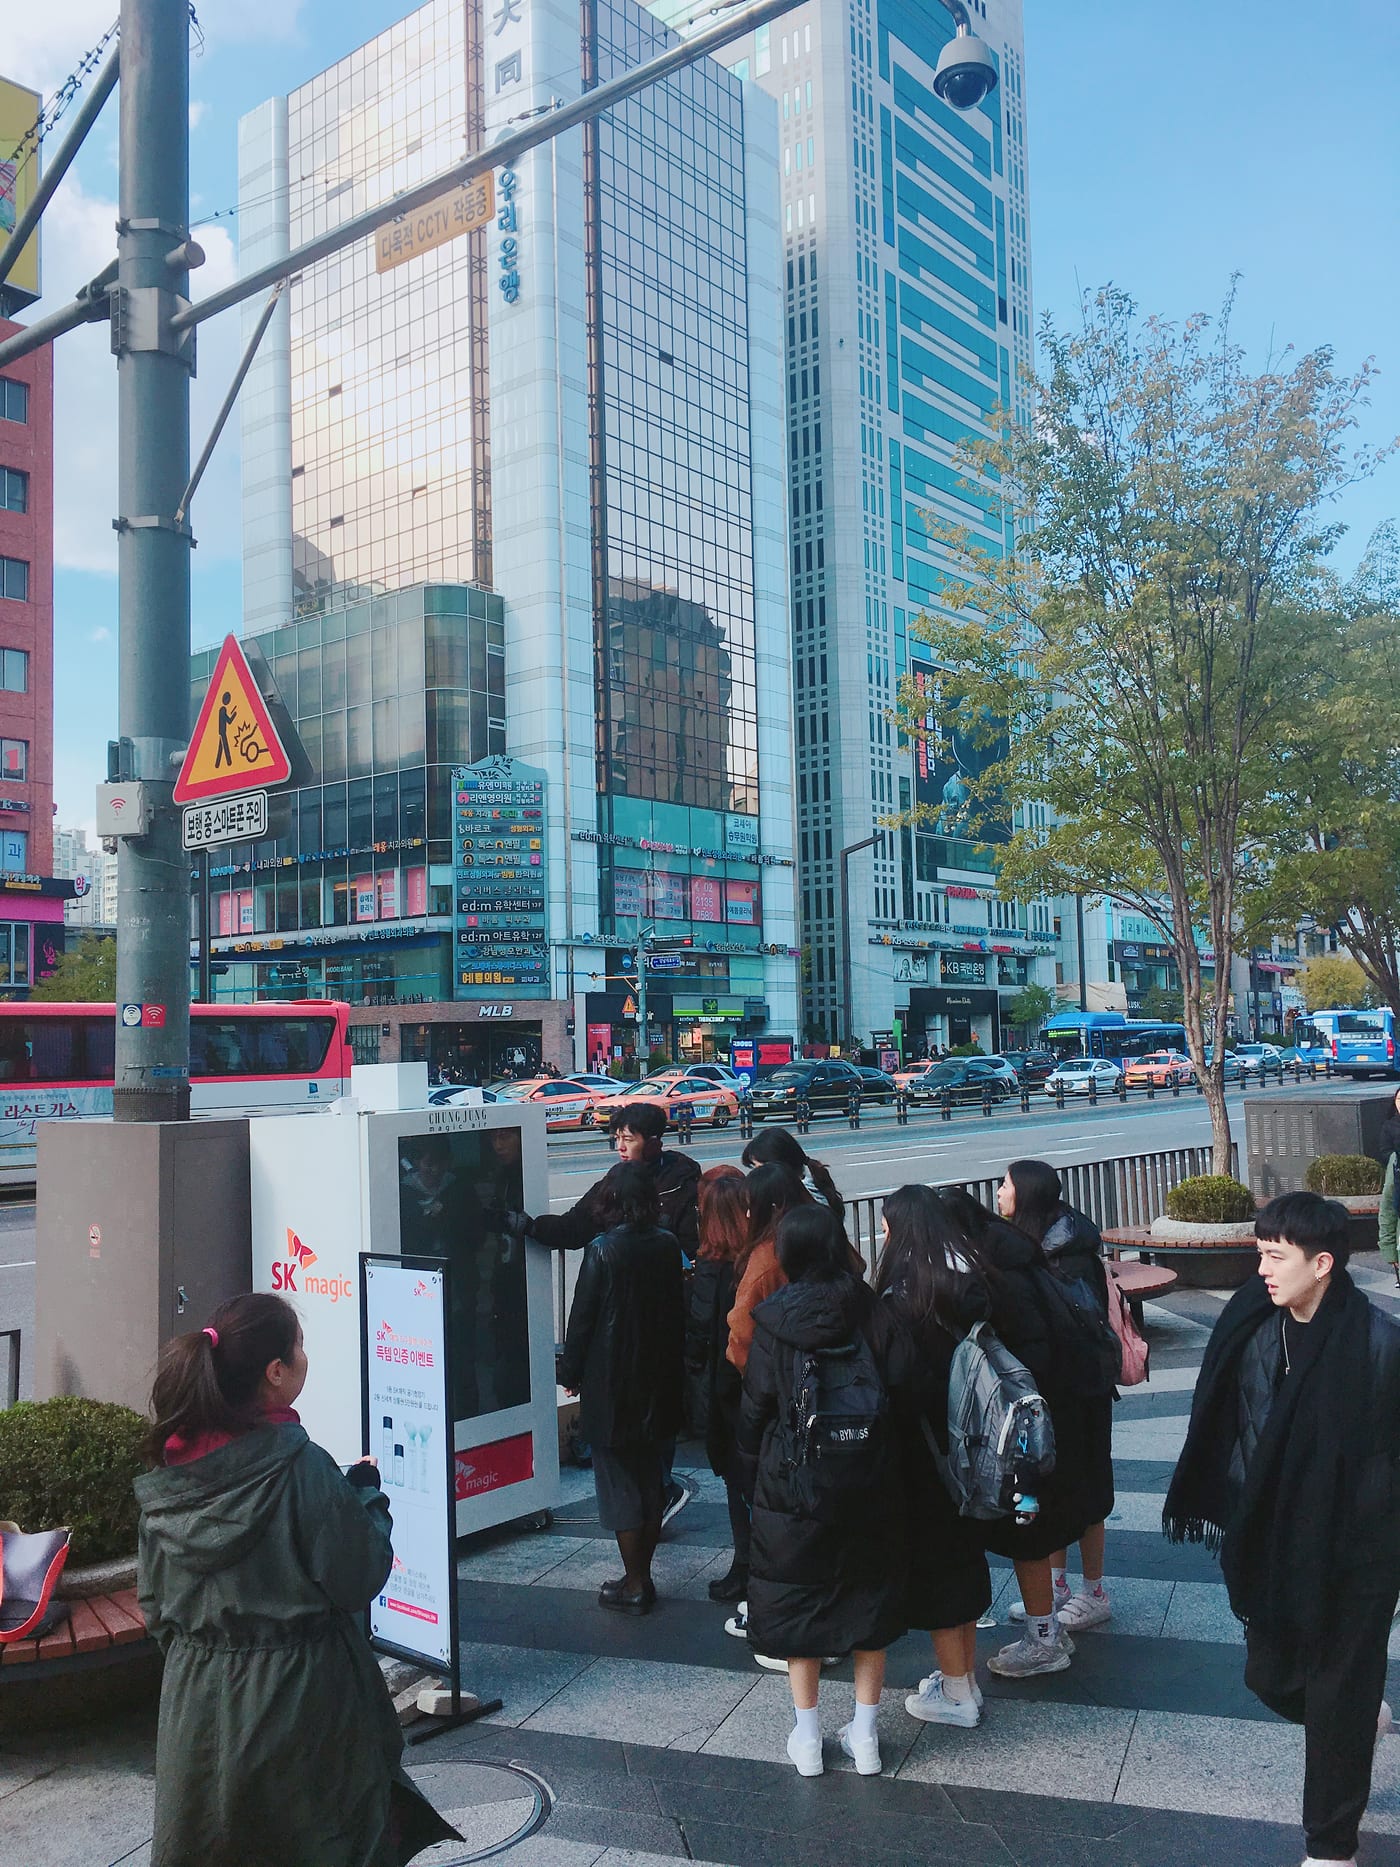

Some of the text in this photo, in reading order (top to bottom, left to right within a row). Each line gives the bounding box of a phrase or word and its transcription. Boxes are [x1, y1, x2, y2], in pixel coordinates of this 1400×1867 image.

[381, 185, 487, 261] 다목적 CCTV 작동중
[498, 169, 521, 304] 우리은행
[187, 797, 262, 841] 보행 중 스마트폰 주의
[76, 876, 85, 892] 약
[462, 900, 491, 911] ed:m
[494, 900, 530, 911] 유학센터
[696, 897, 714, 907] 2135
[461, 930, 490, 942] ed:m
[493, 931, 530, 942] 아트유학
[479, 1005, 513, 1017] MLB
[4, 1101, 80, 1119] 라스트 키스
[429, 1121, 488, 1132] magic air
[271, 1262, 352, 1303] SK magic
[413, 1288, 422, 1297] SK
[376, 1330, 386, 1341] SK
[376, 1344, 434, 1367] 득템 인증 이벤트
[466, 1471, 499, 1491] magic
